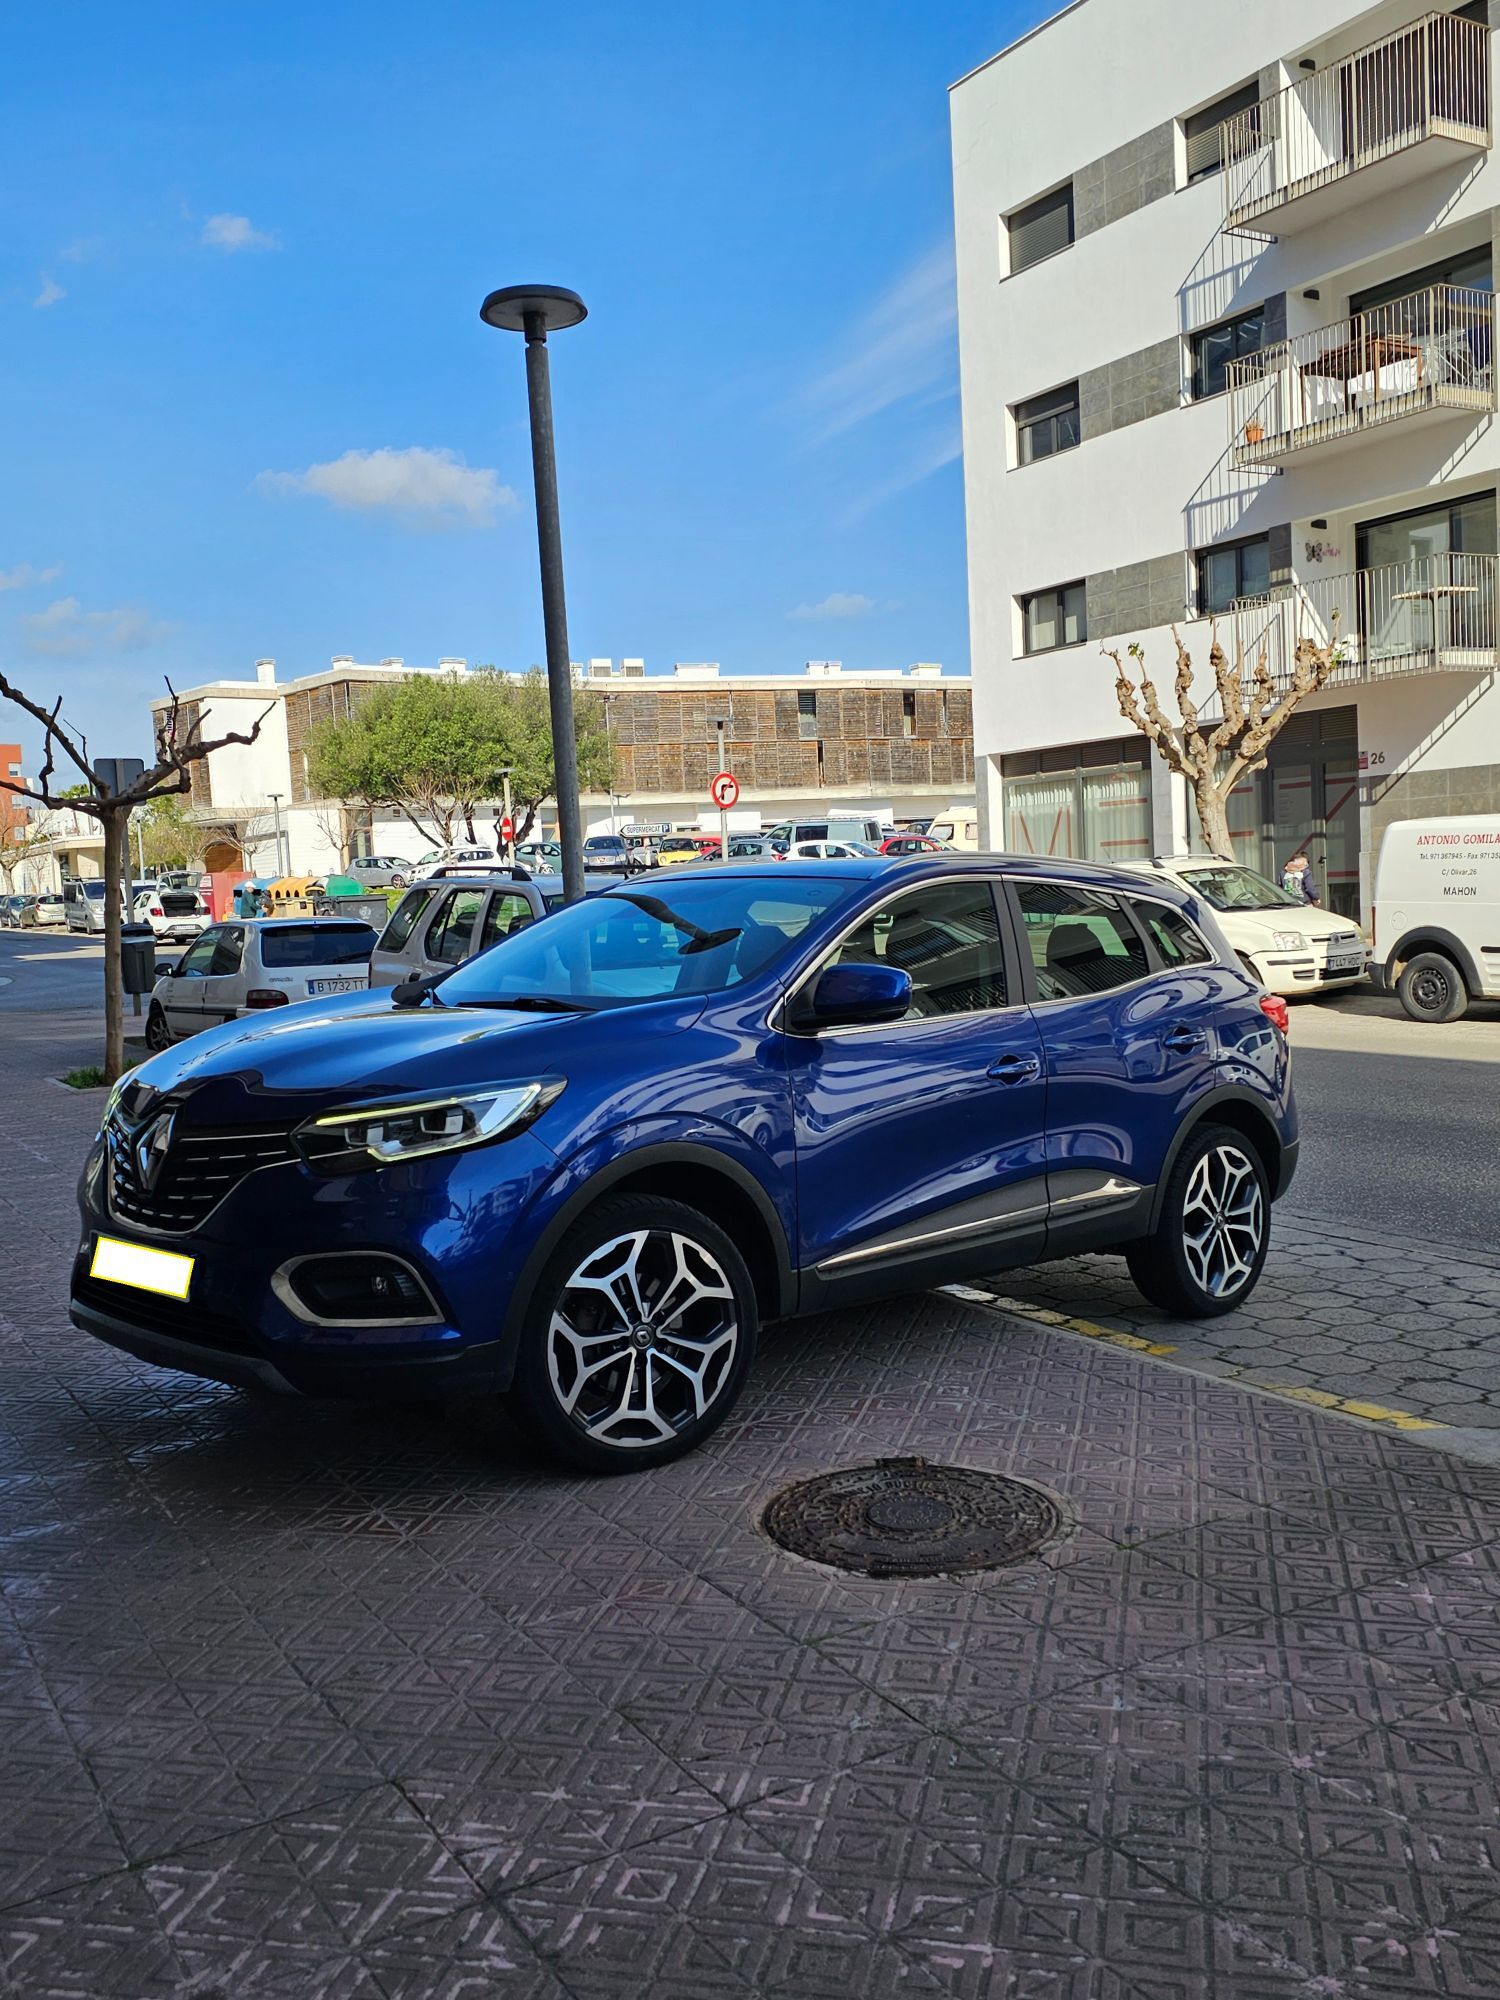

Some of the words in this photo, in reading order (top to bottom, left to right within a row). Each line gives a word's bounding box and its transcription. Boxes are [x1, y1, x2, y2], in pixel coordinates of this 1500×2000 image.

[1371, 752, 1385, 765] 26
[1416, 834, 1460, 845] ANTONIO
[1443, 886, 1477, 896] MAHON
[317, 982, 324, 992] B
[327, 981, 351, 992] 1732
[353, 980, 364, 990] TT
